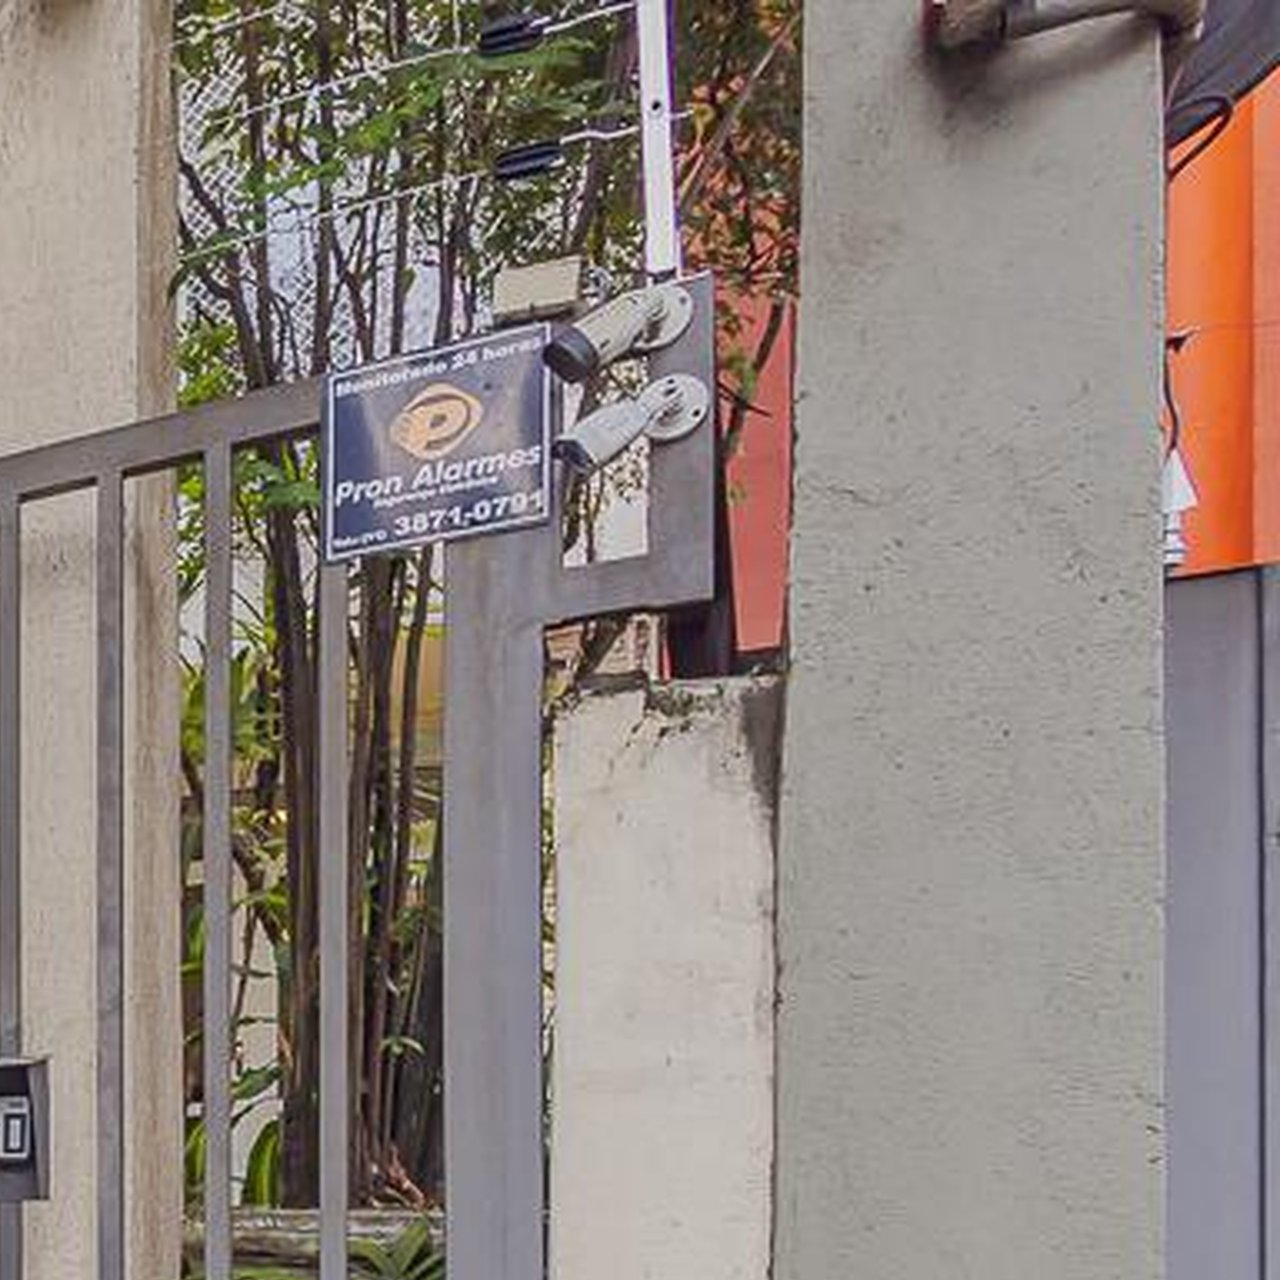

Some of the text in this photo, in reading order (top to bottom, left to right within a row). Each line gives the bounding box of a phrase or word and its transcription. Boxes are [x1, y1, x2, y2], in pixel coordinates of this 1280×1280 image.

[336, 335, 543, 398] Monitorado 24 horas
[336, 475, 403, 507] Pron
[411, 445, 541, 489] Alarmes
